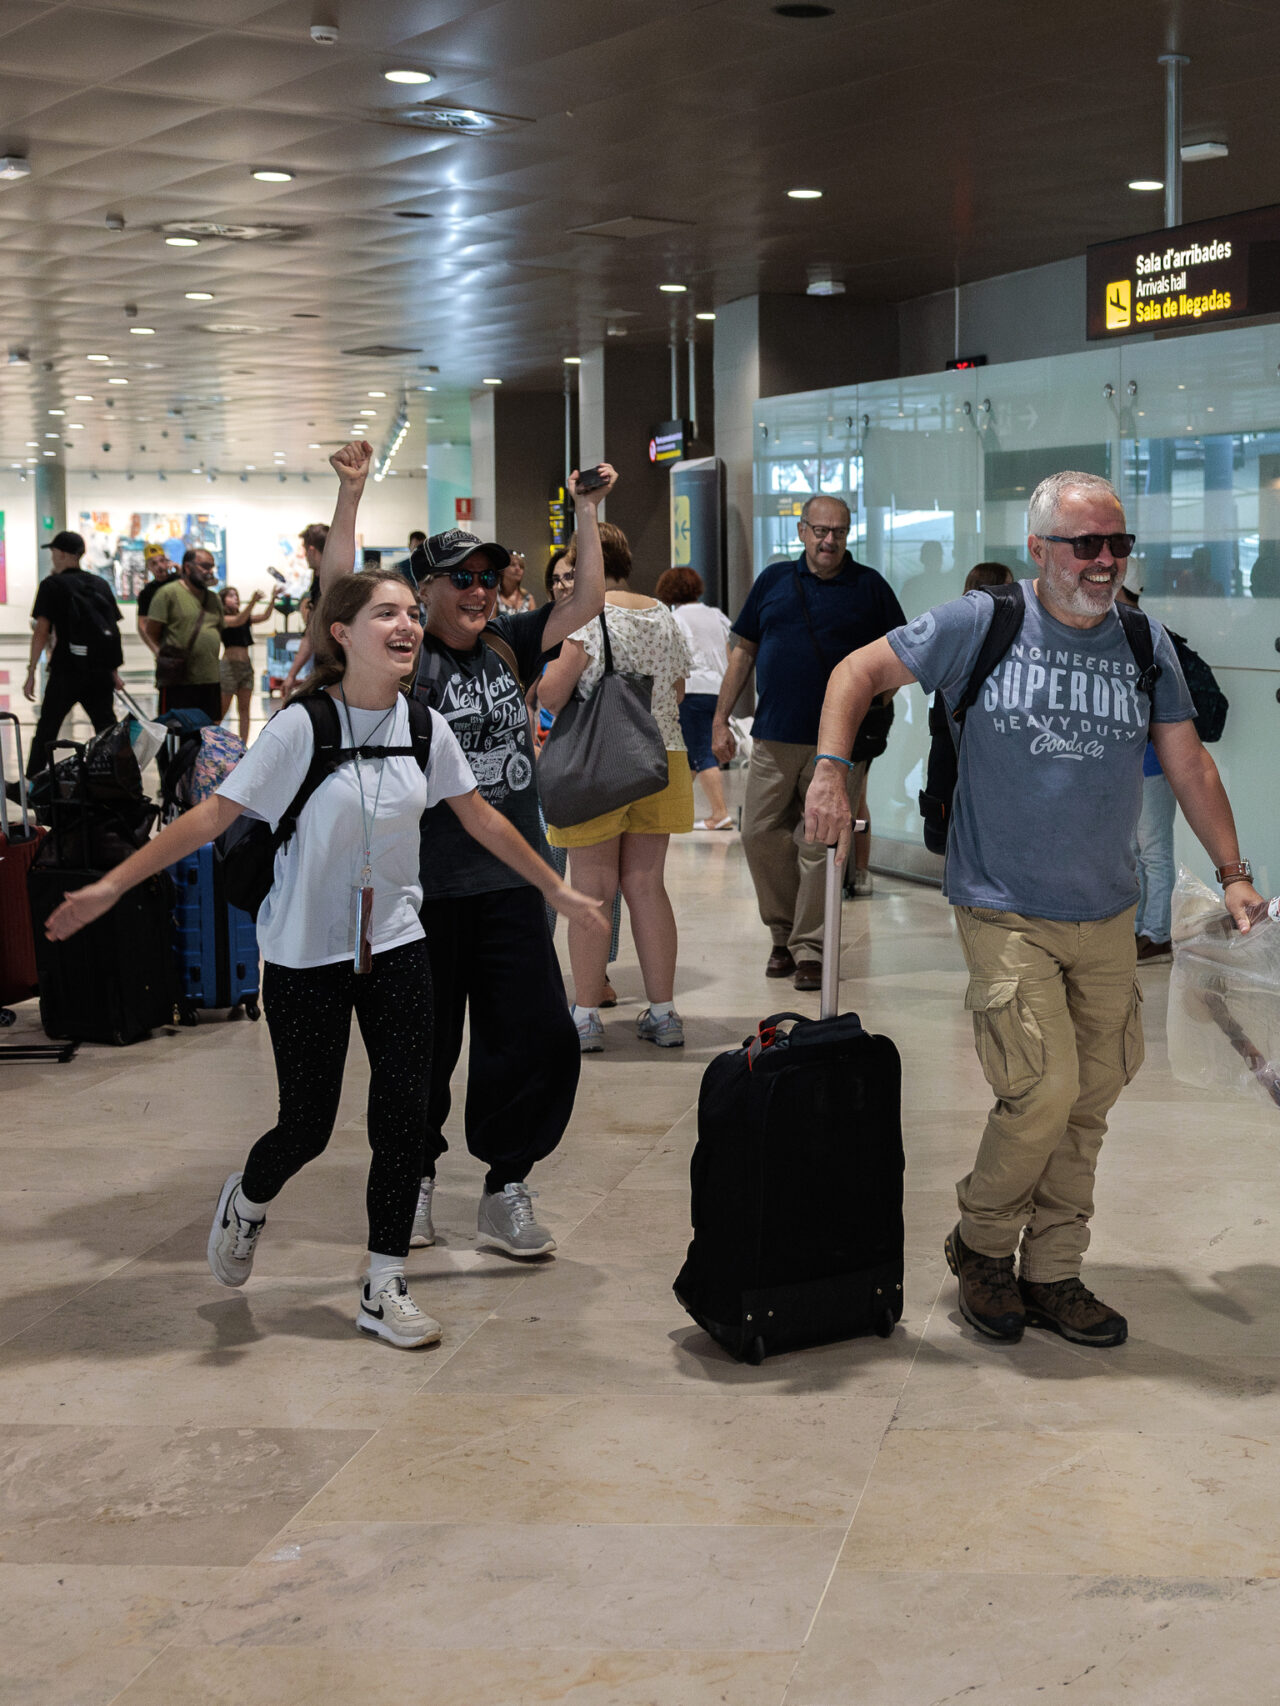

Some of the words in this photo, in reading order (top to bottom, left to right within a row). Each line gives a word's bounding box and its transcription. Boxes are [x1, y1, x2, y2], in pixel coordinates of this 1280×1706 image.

[1136, 252, 1161, 275] Sala
[1163, 240, 1232, 270] d'arribades
[1136, 275, 1170, 298] Arrivals
[1170, 271, 1186, 291] hall
[1136, 300, 1161, 322] Sala
[1163, 297, 1178, 319] de
[1179, 289, 1232, 318] llegadas
[1011, 644, 1136, 676] NGINEERED
[993, 714, 1071, 734] HEAVY
[1081, 719, 1136, 742] DUTY
[1030, 731, 1083, 755] Goods
